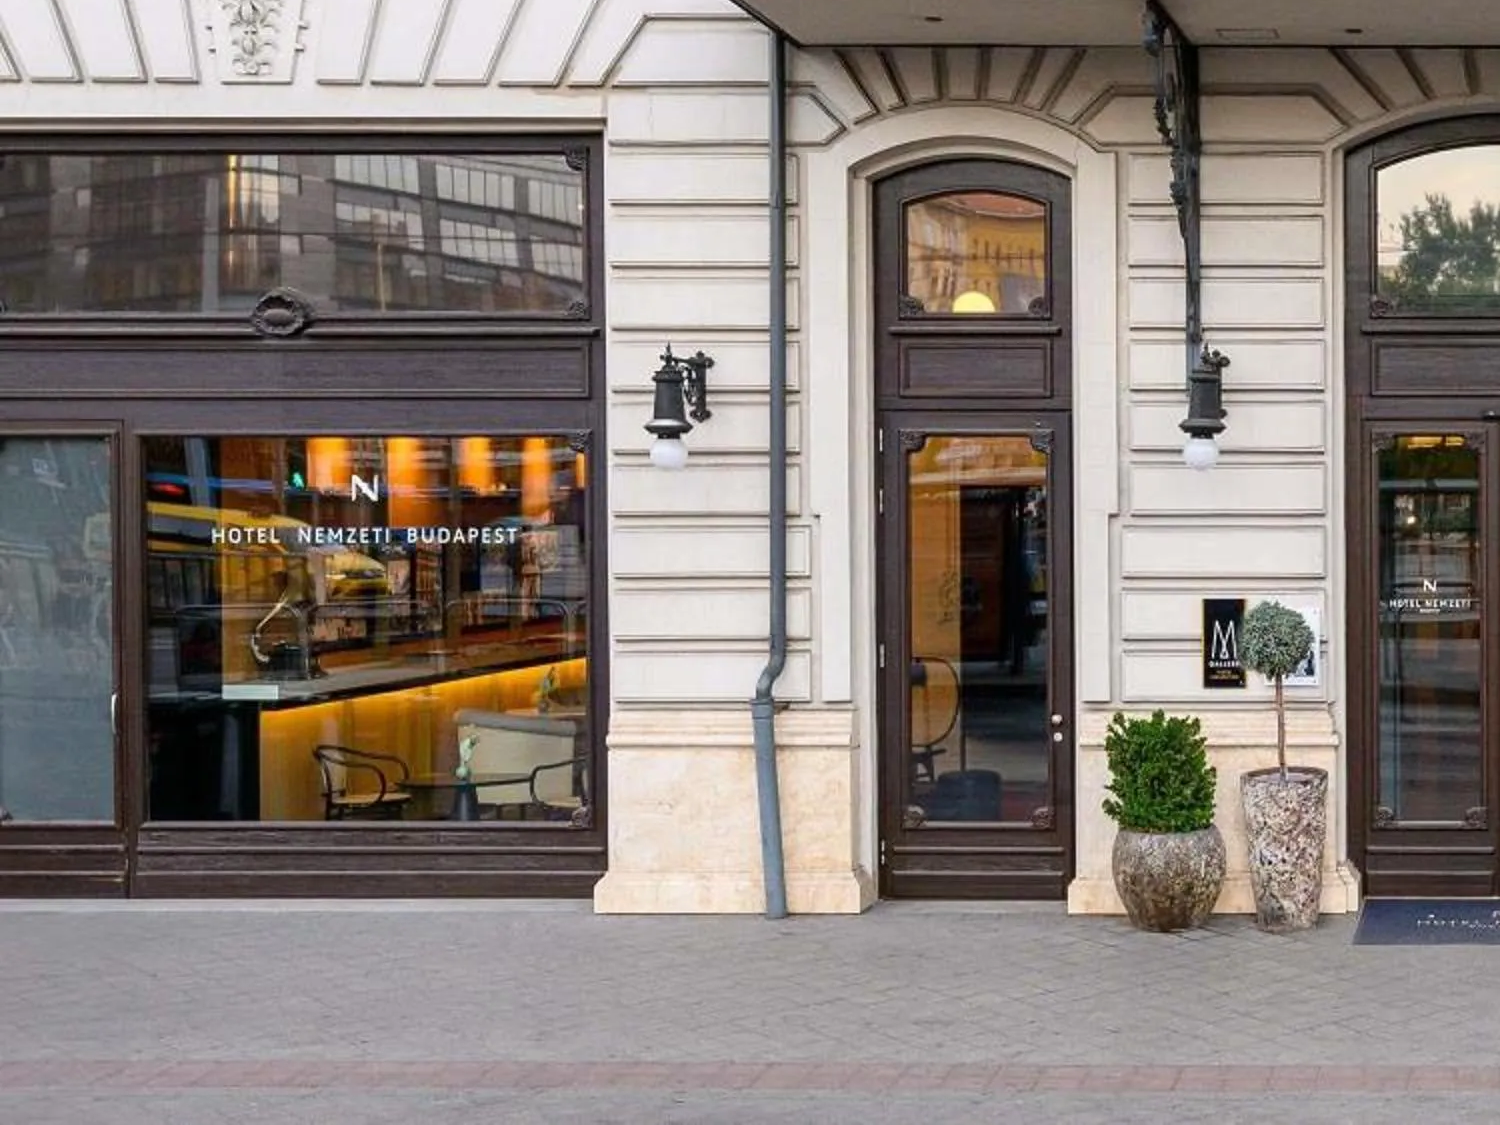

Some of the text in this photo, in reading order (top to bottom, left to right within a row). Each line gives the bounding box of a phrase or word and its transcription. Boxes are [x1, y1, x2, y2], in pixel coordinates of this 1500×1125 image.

[351, 475, 378, 502] N
[211, 528, 518, 544] HOTEL NEMZETI BUDAPEST
[1423, 579, 1437, 592] N
[1389, 598, 1421, 608] HOTEL
